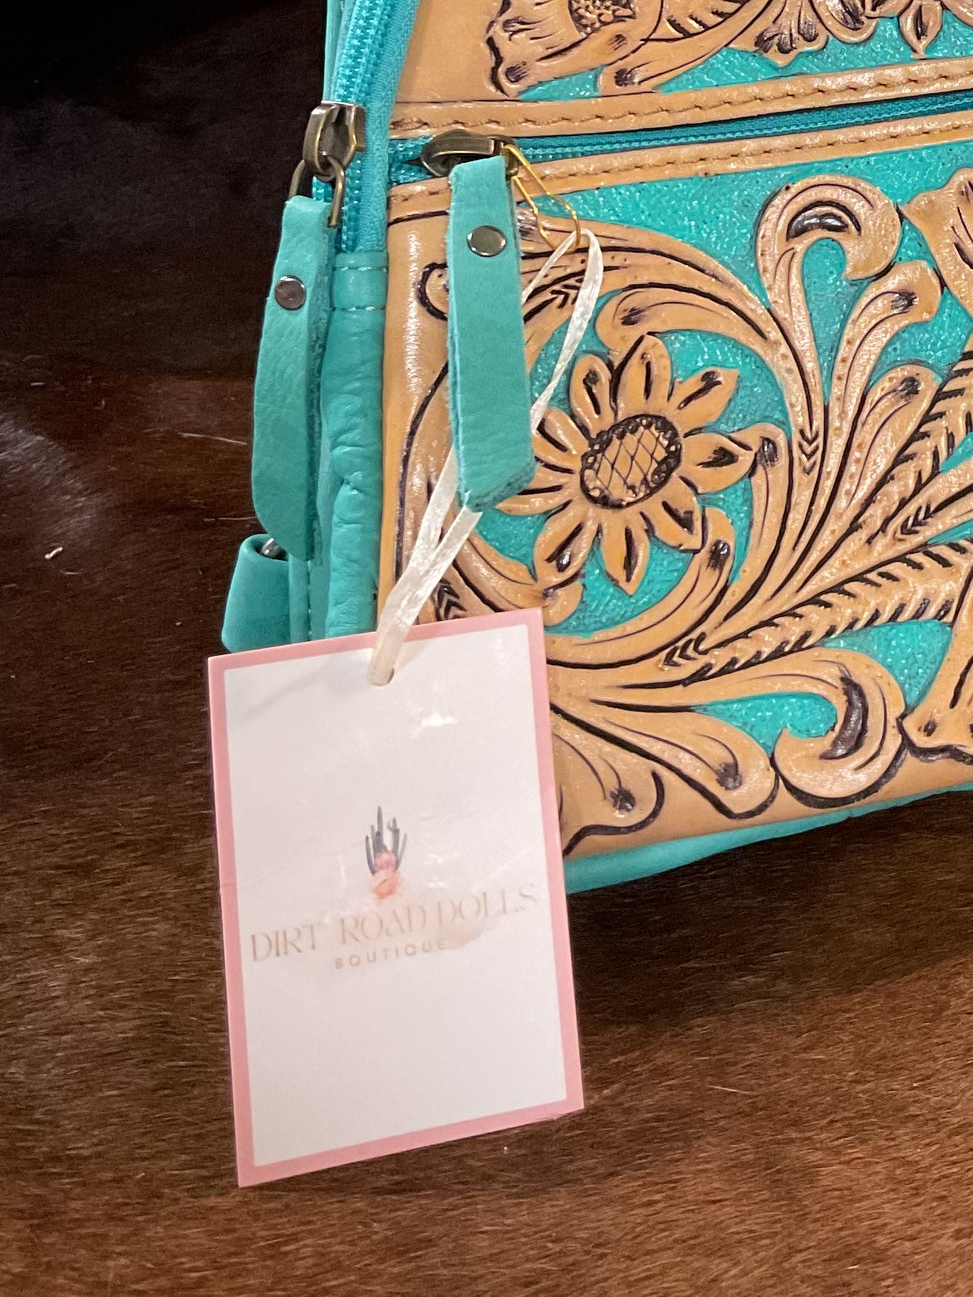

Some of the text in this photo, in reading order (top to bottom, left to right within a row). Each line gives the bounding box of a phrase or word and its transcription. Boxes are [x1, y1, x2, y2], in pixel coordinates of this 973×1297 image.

[250, 883, 537, 962] DIRT ROAD DOLLS
[335, 939, 446, 970] BOUTIQUE
